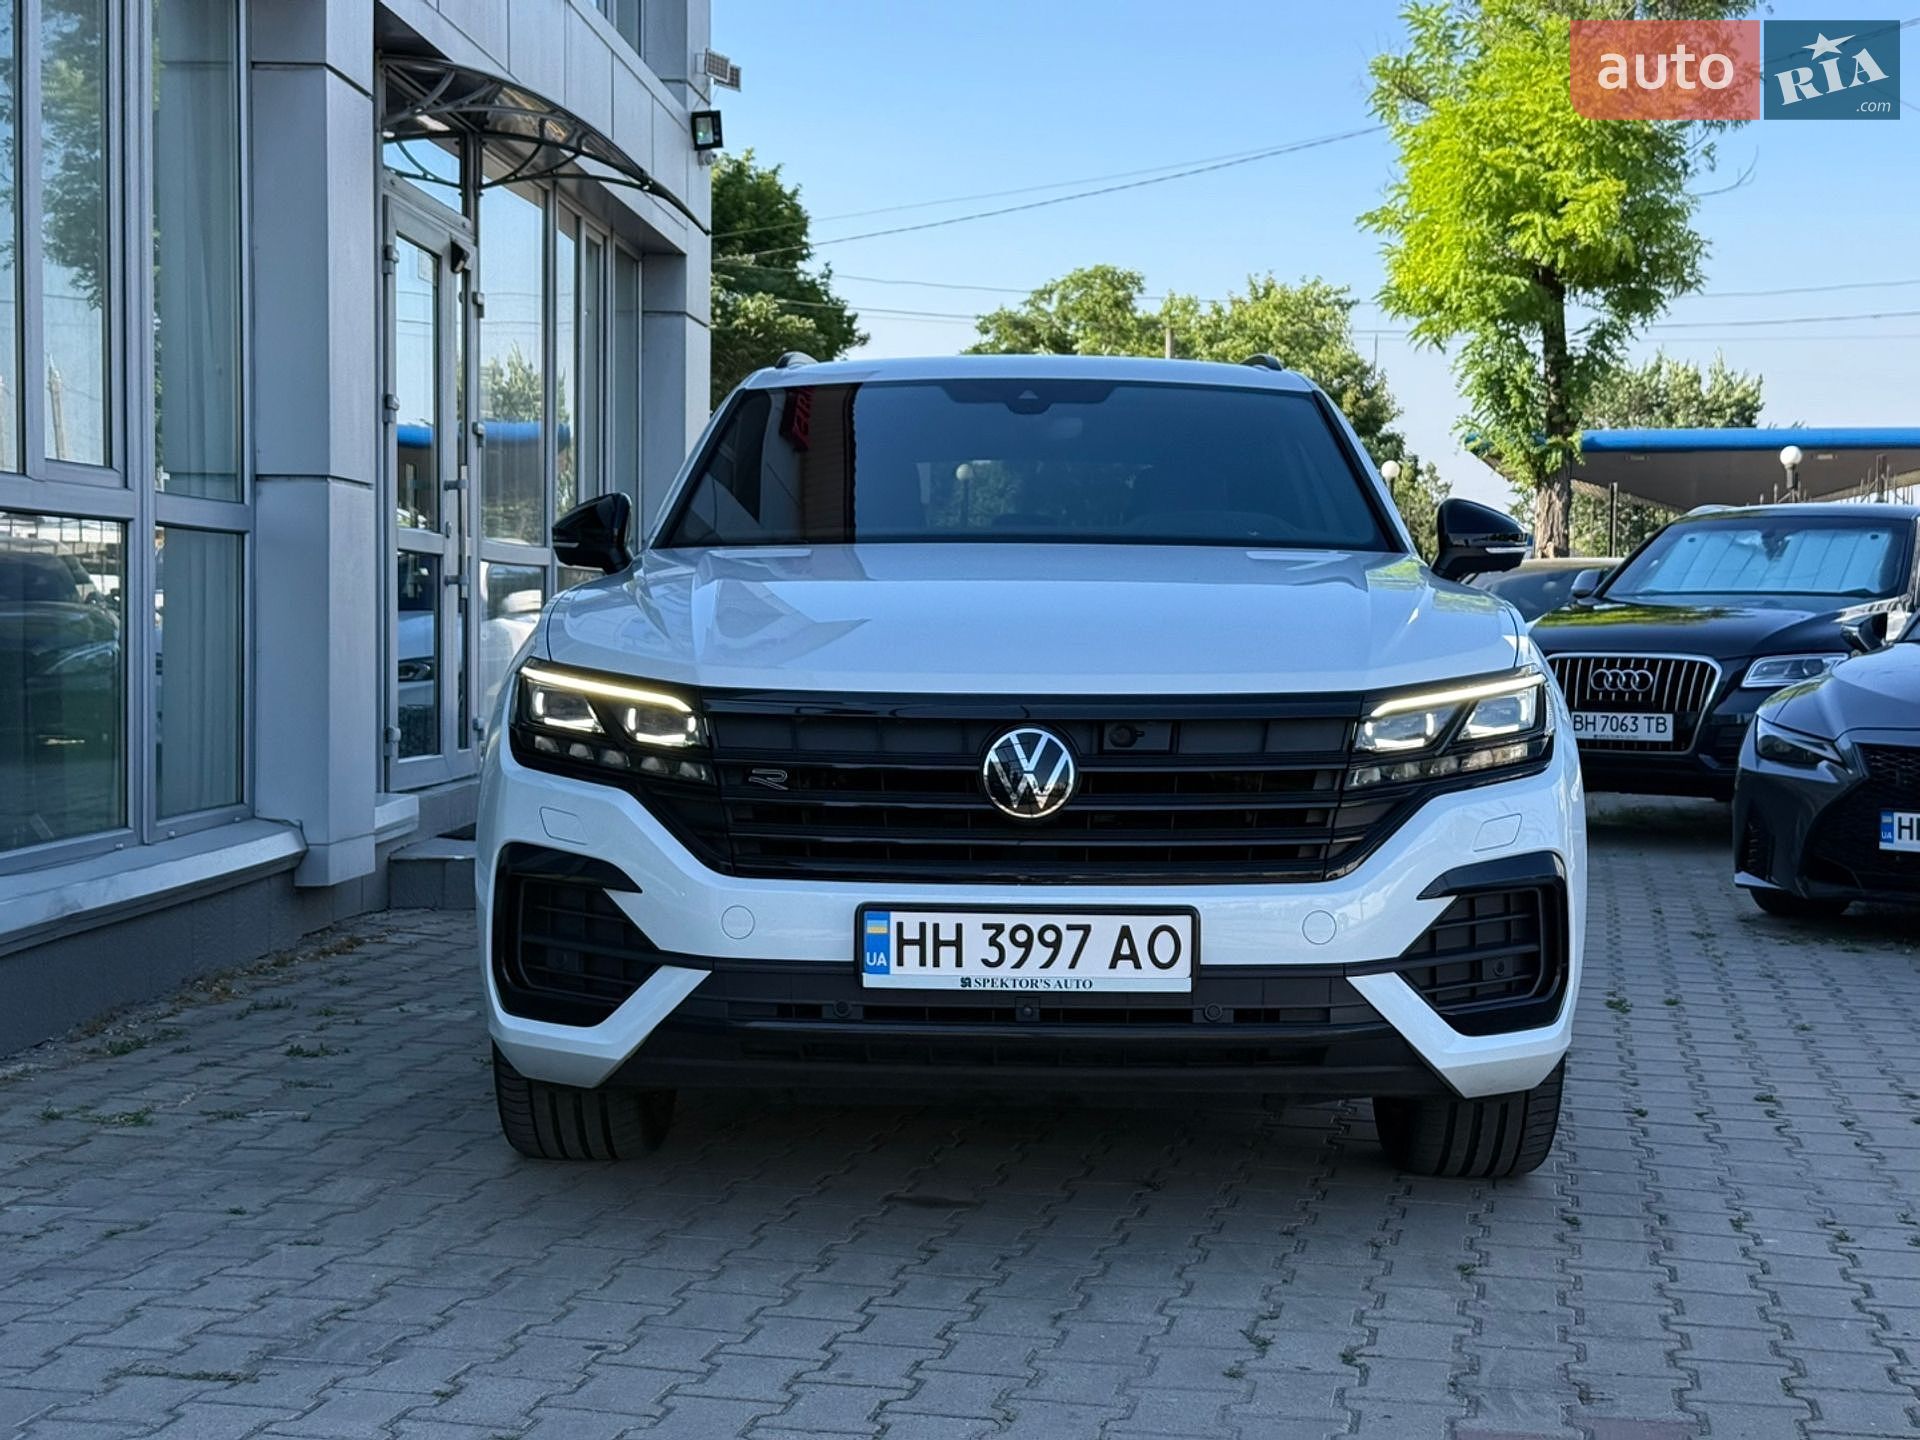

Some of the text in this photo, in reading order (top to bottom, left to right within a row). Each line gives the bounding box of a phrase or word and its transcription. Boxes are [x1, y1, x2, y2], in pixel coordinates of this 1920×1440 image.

[1573, 714, 1667, 733] BH 7063 TB
[1881, 831, 1892, 839] UA
[1898, 816, 1920, 841] H
[896, 921, 1182, 970] HH 3997 AO
[866, 952, 887, 967] UA
[974, 978, 1050, 989] SPEKTOR'S
[1054, 979, 1093, 989] AUTO
